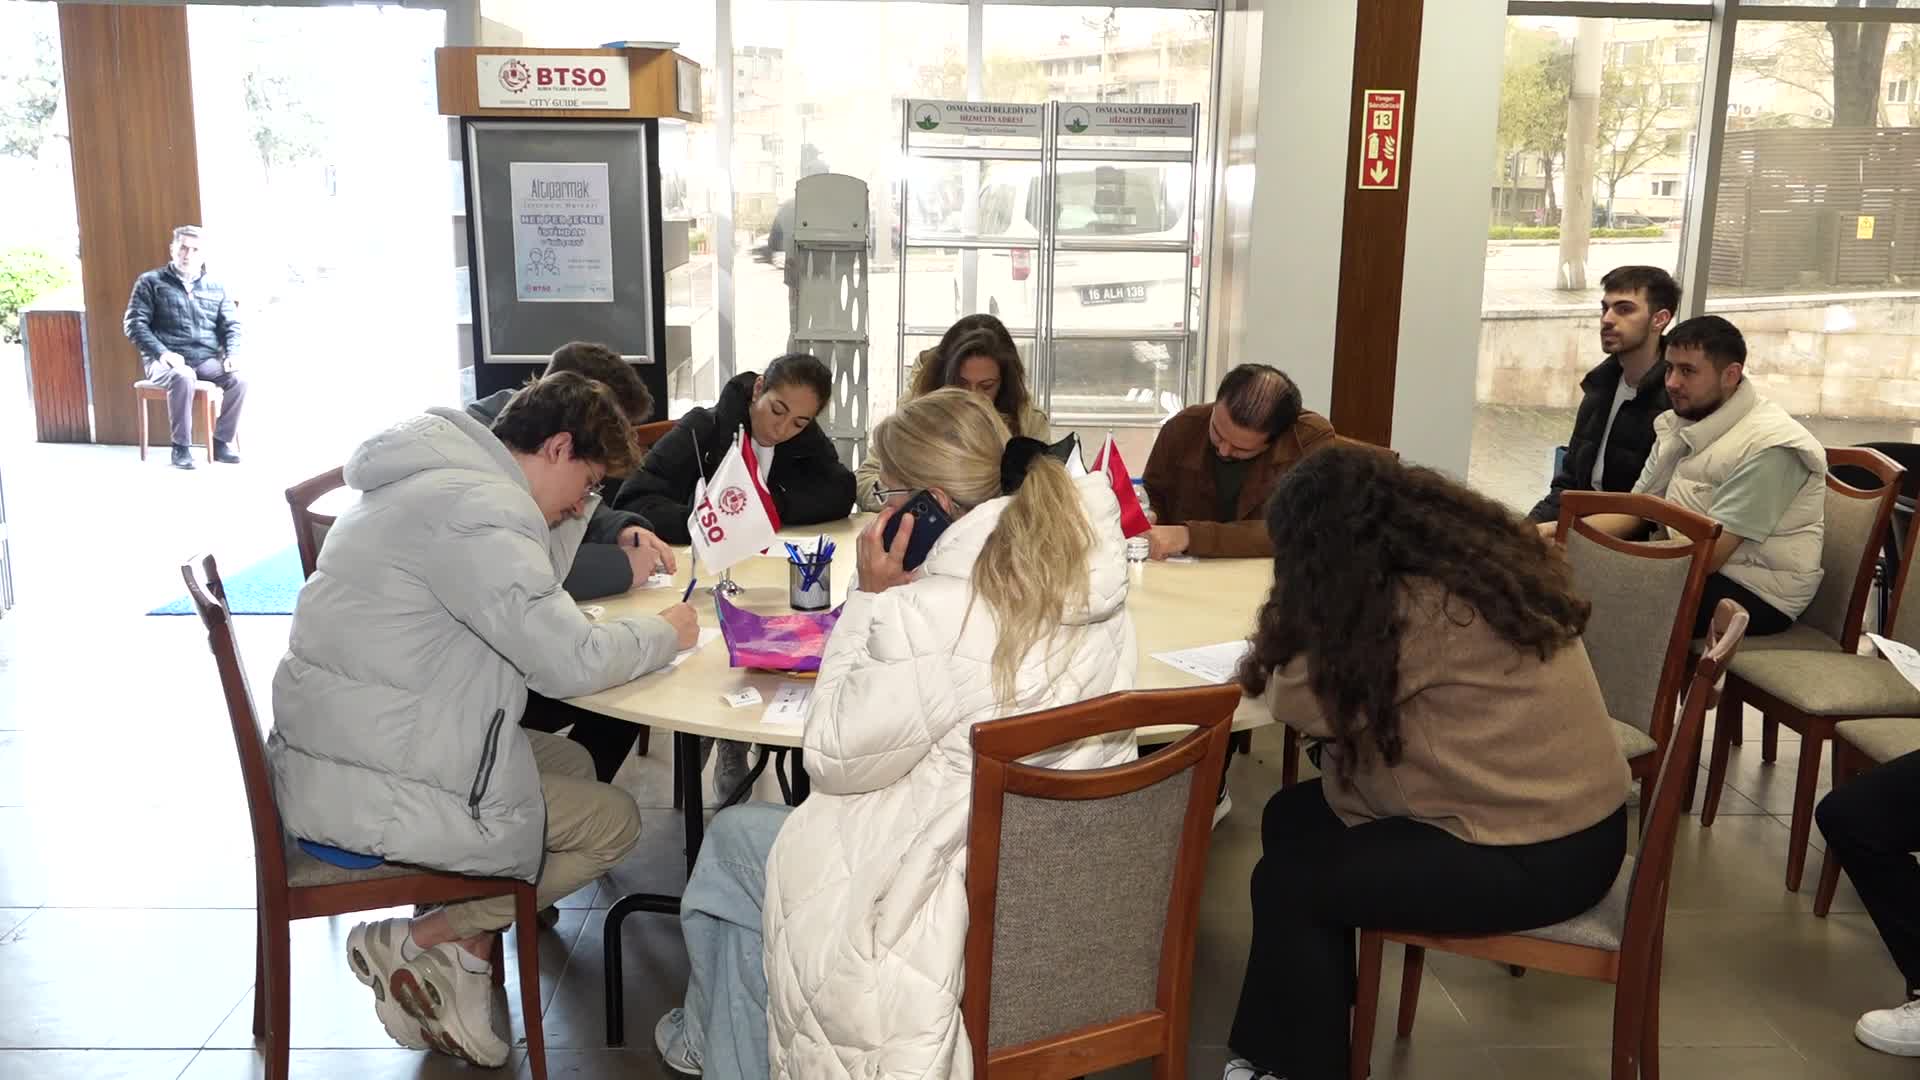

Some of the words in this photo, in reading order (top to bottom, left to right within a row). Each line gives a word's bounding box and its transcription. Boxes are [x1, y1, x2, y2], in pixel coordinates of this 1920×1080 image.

[537, 67, 607, 86] BTSO
[529, 99, 550, 107] CITY
[552, 99, 580, 107] GUIDE
[946, 103, 991, 113] OSMANGAZİ
[993, 105, 1037, 114] BELEDİYESİ
[1375, 114, 1391, 126] 13
[531, 179, 590, 200] Altıparmak
[1089, 288, 1100, 300] 16
[1104, 287, 1124, 299] ALH
[697, 493, 724, 543] TSO
